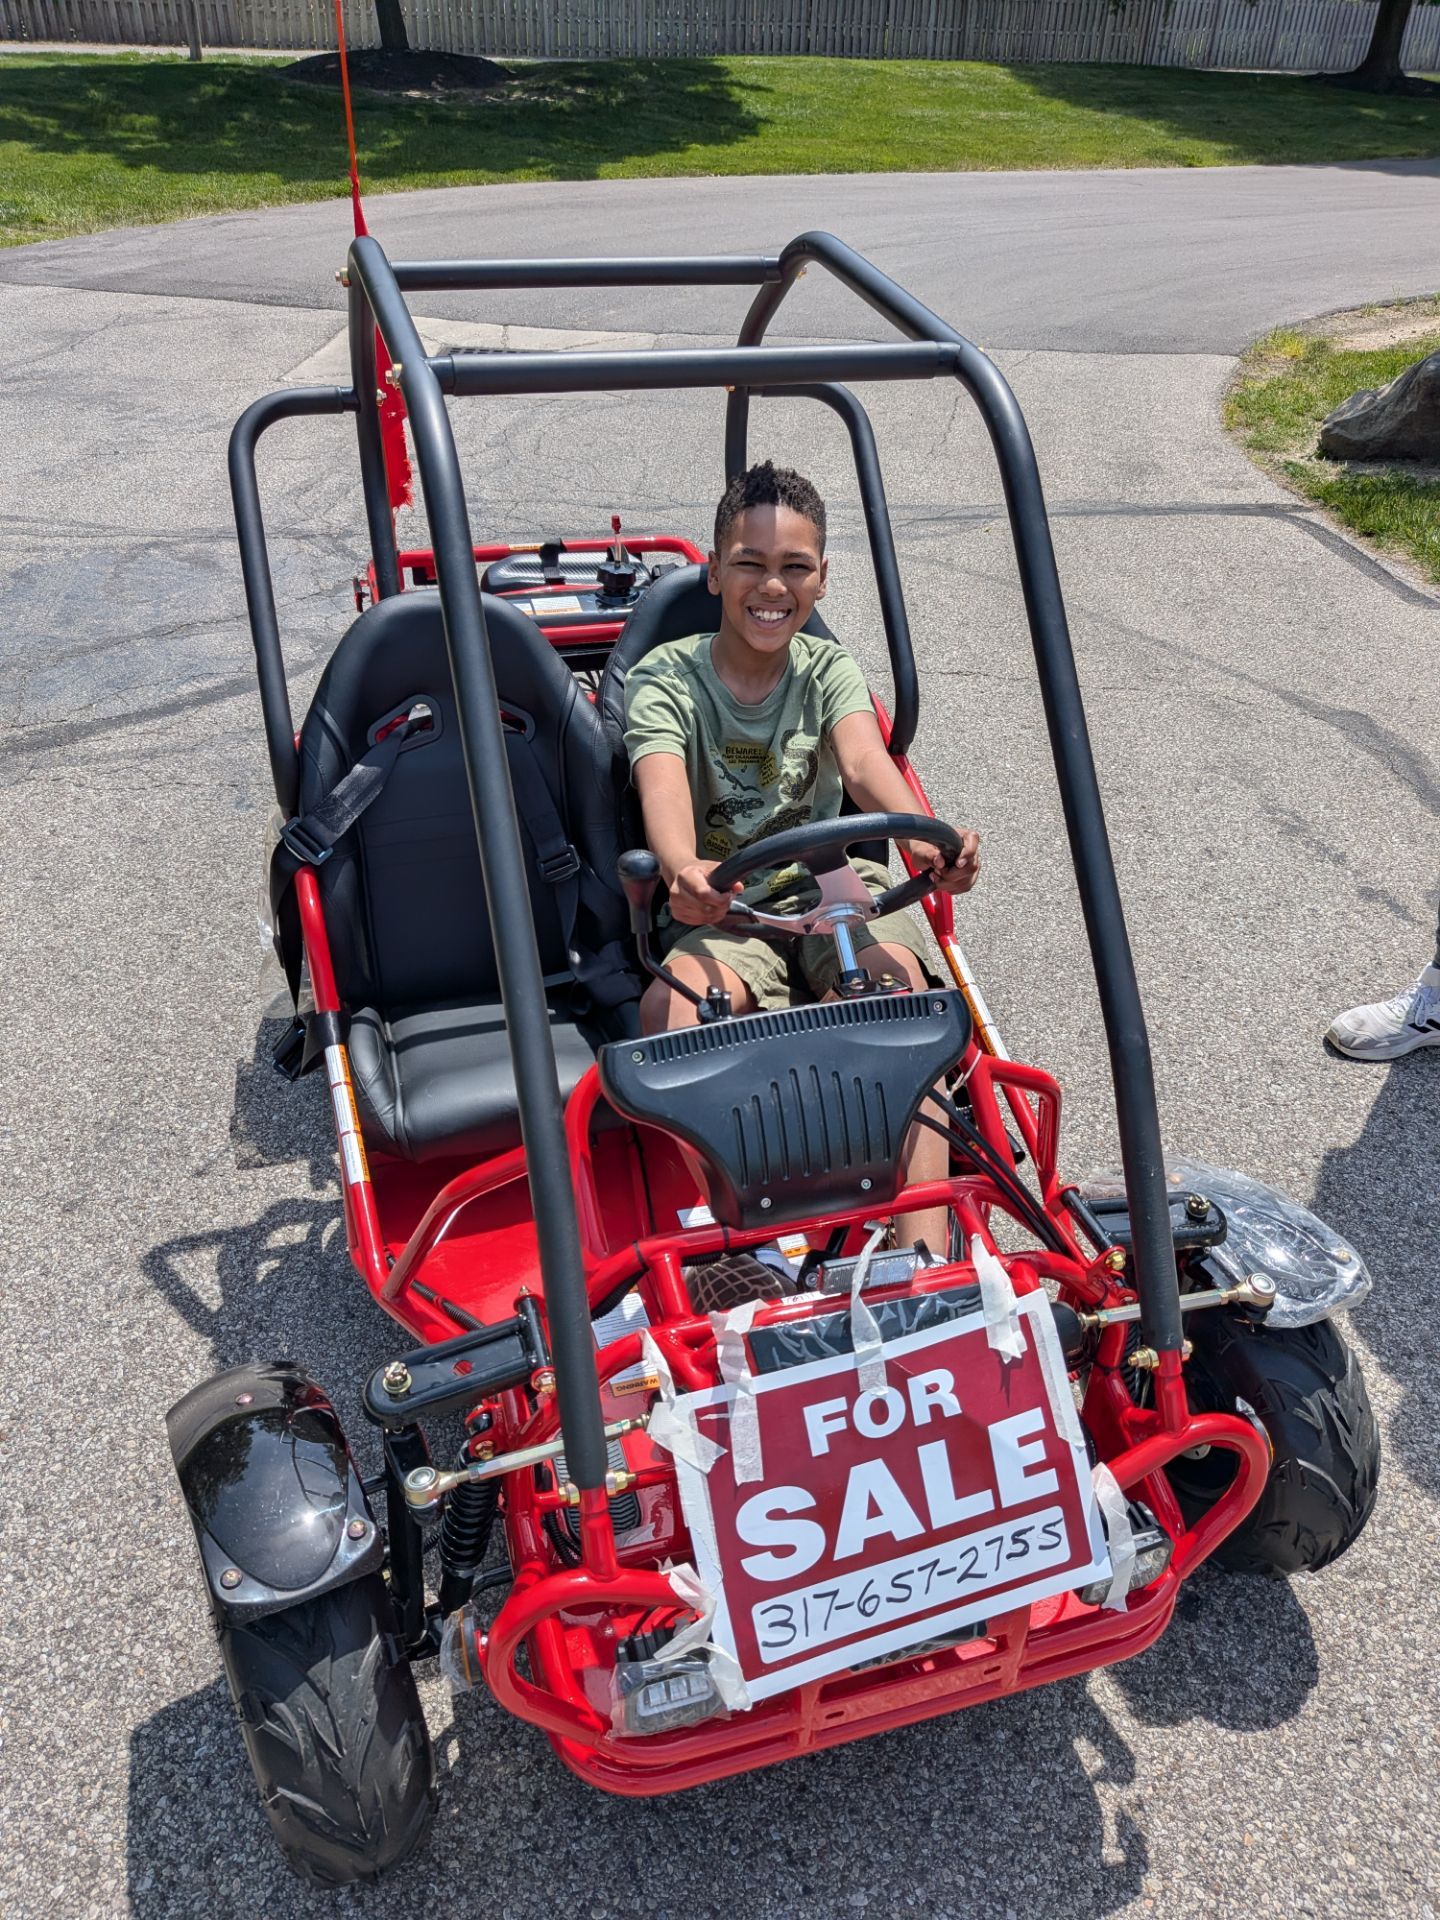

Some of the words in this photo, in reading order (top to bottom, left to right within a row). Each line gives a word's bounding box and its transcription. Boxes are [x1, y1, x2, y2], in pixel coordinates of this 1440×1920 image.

[615, 1378, 658, 1392] WARNING
[803, 1368, 962, 1457] FOR
[735, 1407, 1060, 1581] SALE
[761, 1517, 1065, 1649] 317-657-2755
